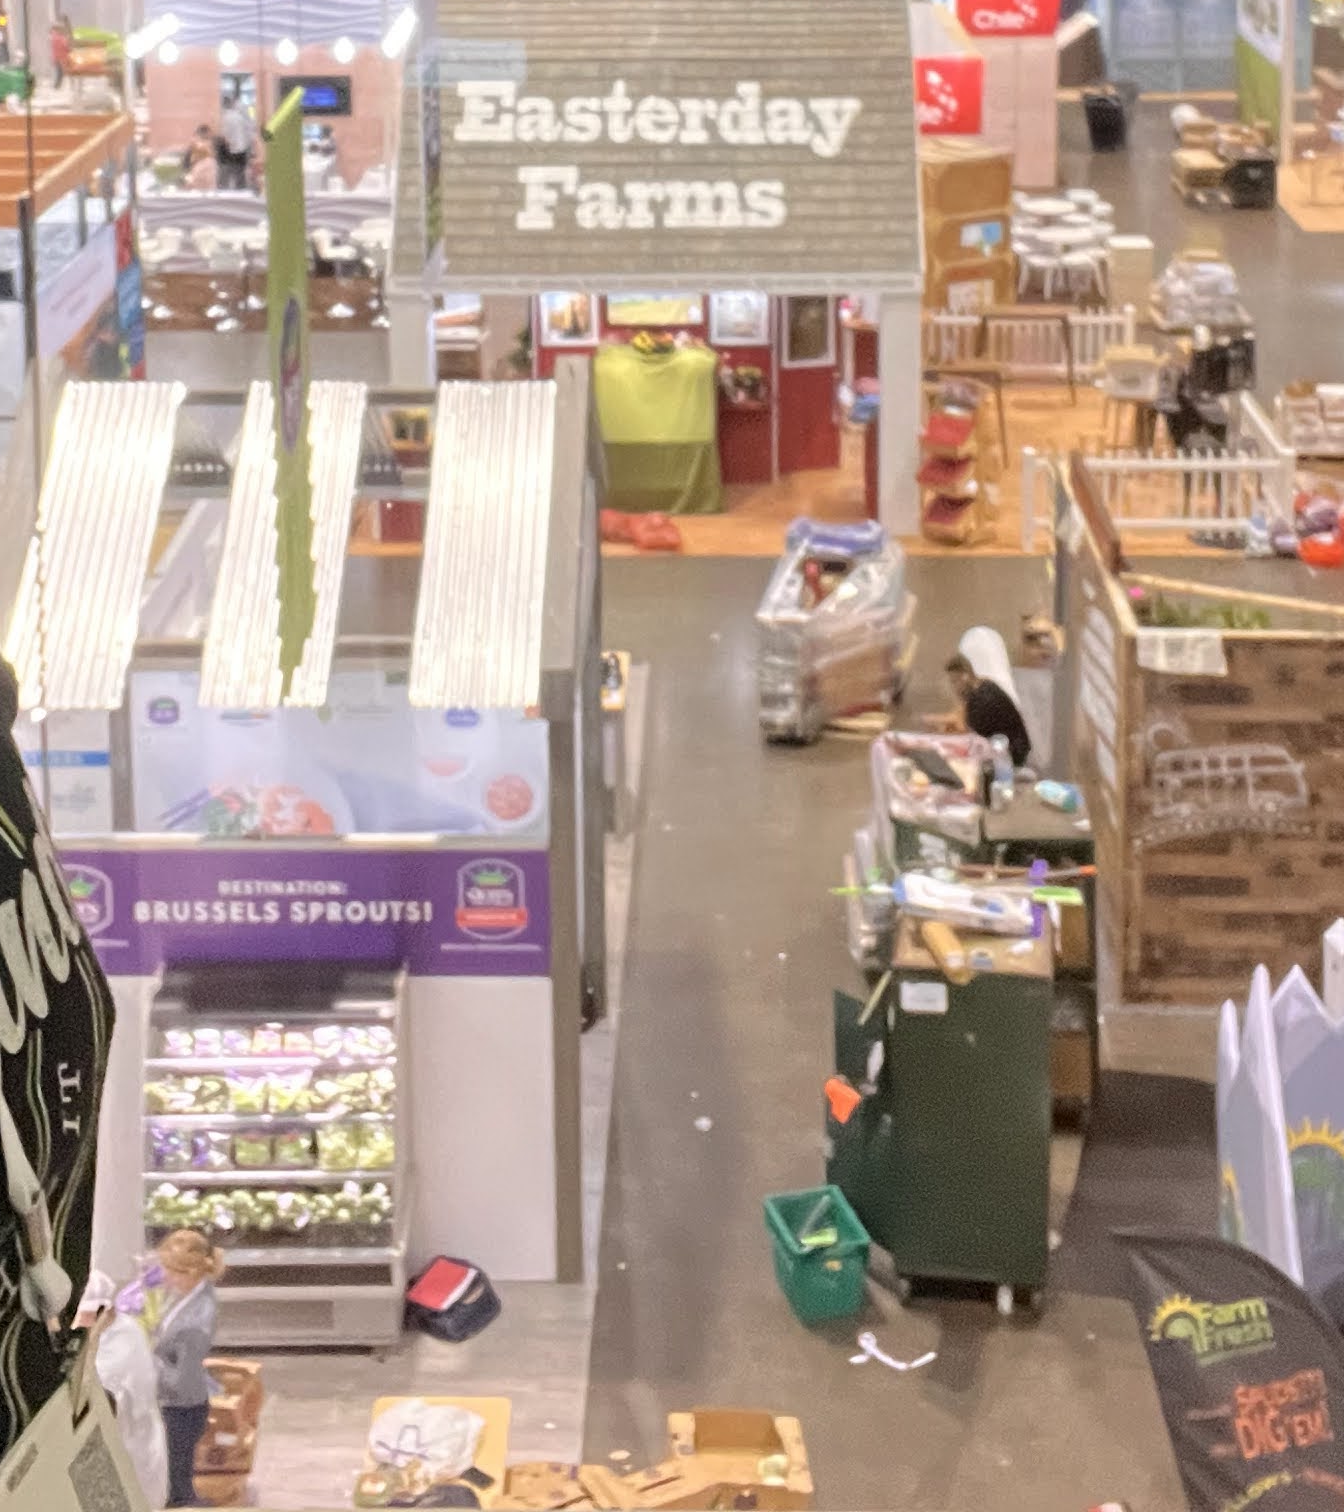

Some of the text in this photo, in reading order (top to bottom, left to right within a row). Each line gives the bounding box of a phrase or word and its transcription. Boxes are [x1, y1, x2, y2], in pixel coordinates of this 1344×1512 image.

[453, 77, 863, 158] Easterday
[515, 164, 788, 231] Farms
[217, 879, 348, 898] DESTINATION:
[133, 900, 282, 924] BRUSSELS
[289, 899, 434, 925] SPROUTS!
[1201, 1297, 1269, 1326] Farm
